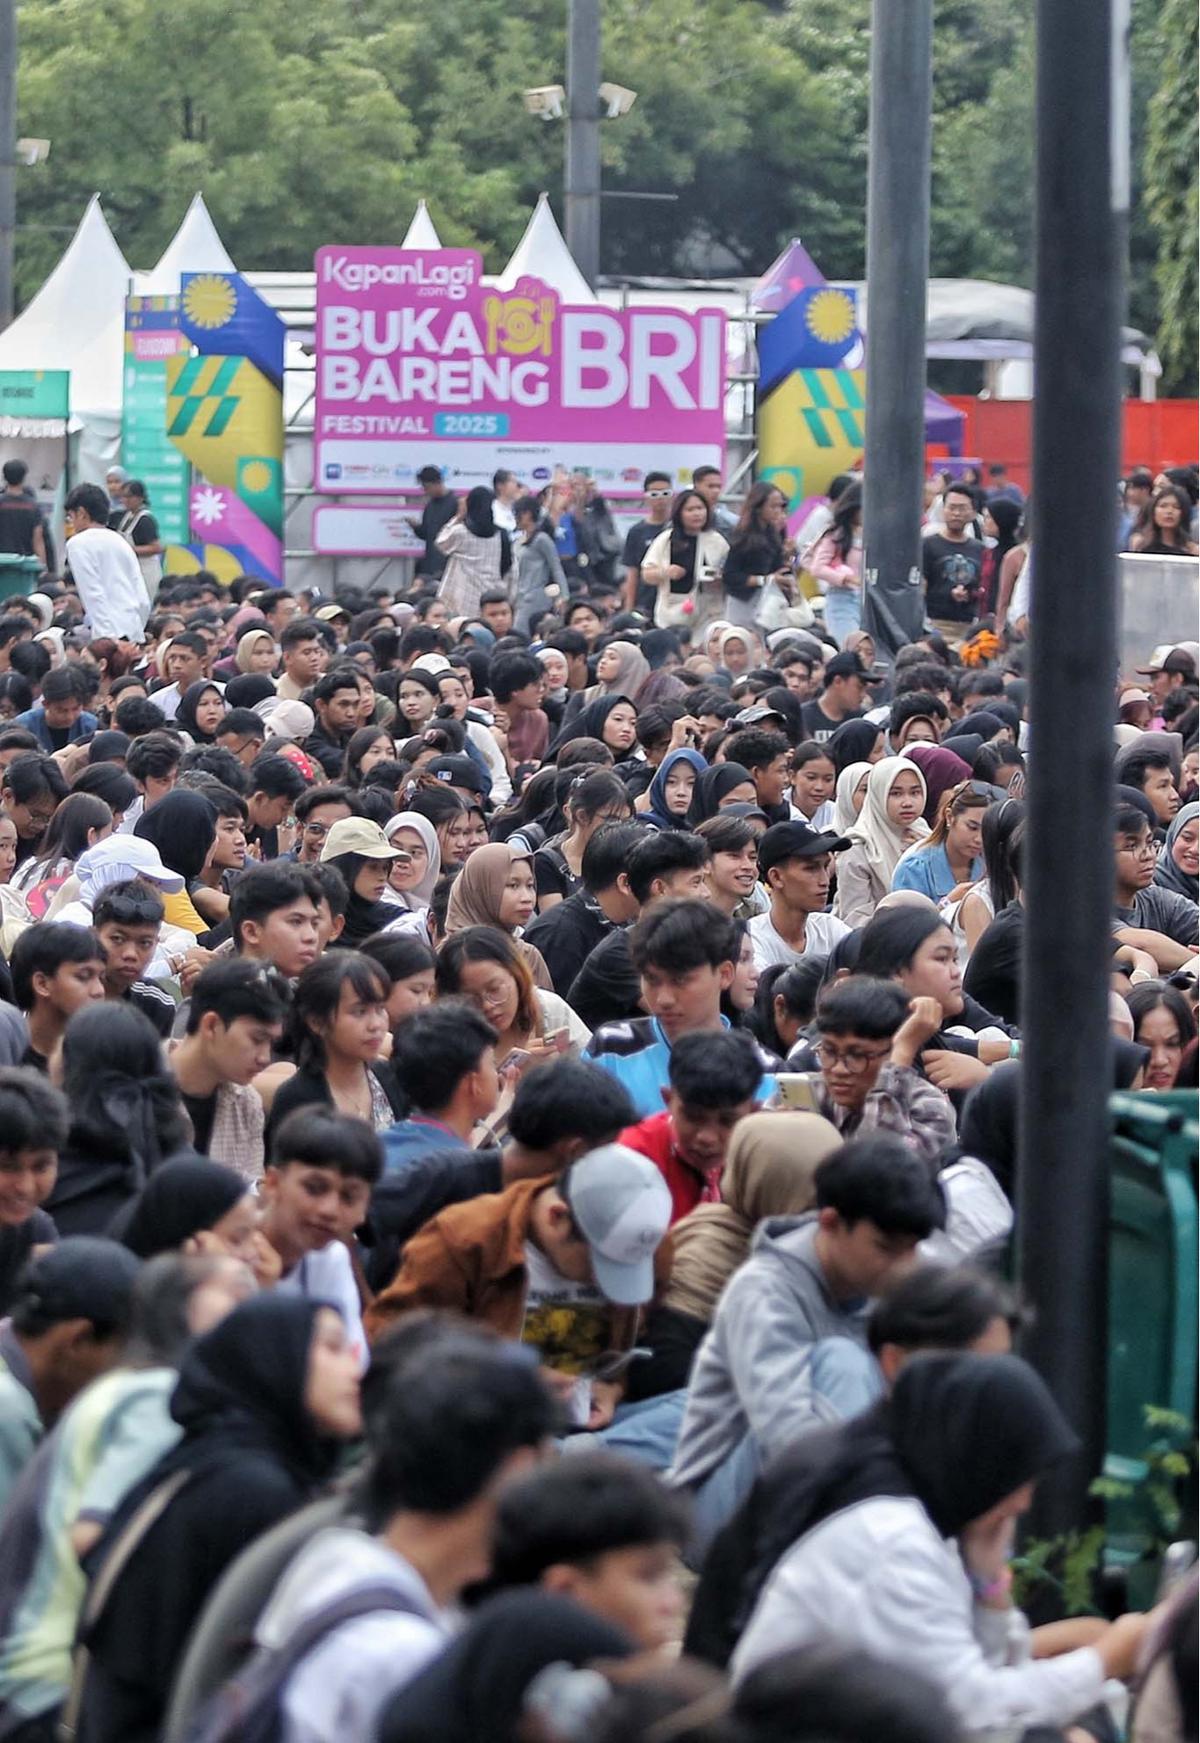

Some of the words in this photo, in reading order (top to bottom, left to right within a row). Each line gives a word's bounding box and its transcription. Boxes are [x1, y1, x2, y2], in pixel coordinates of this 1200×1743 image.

[324, 256, 474, 299] KapanLagi
[323, 306, 485, 356] BUKA
[322, 355, 550, 407] BARENG
[561, 312, 721, 411] BRI
[322, 415, 429, 435] FESTIVAL
[444, 415, 498, 435] 2025
